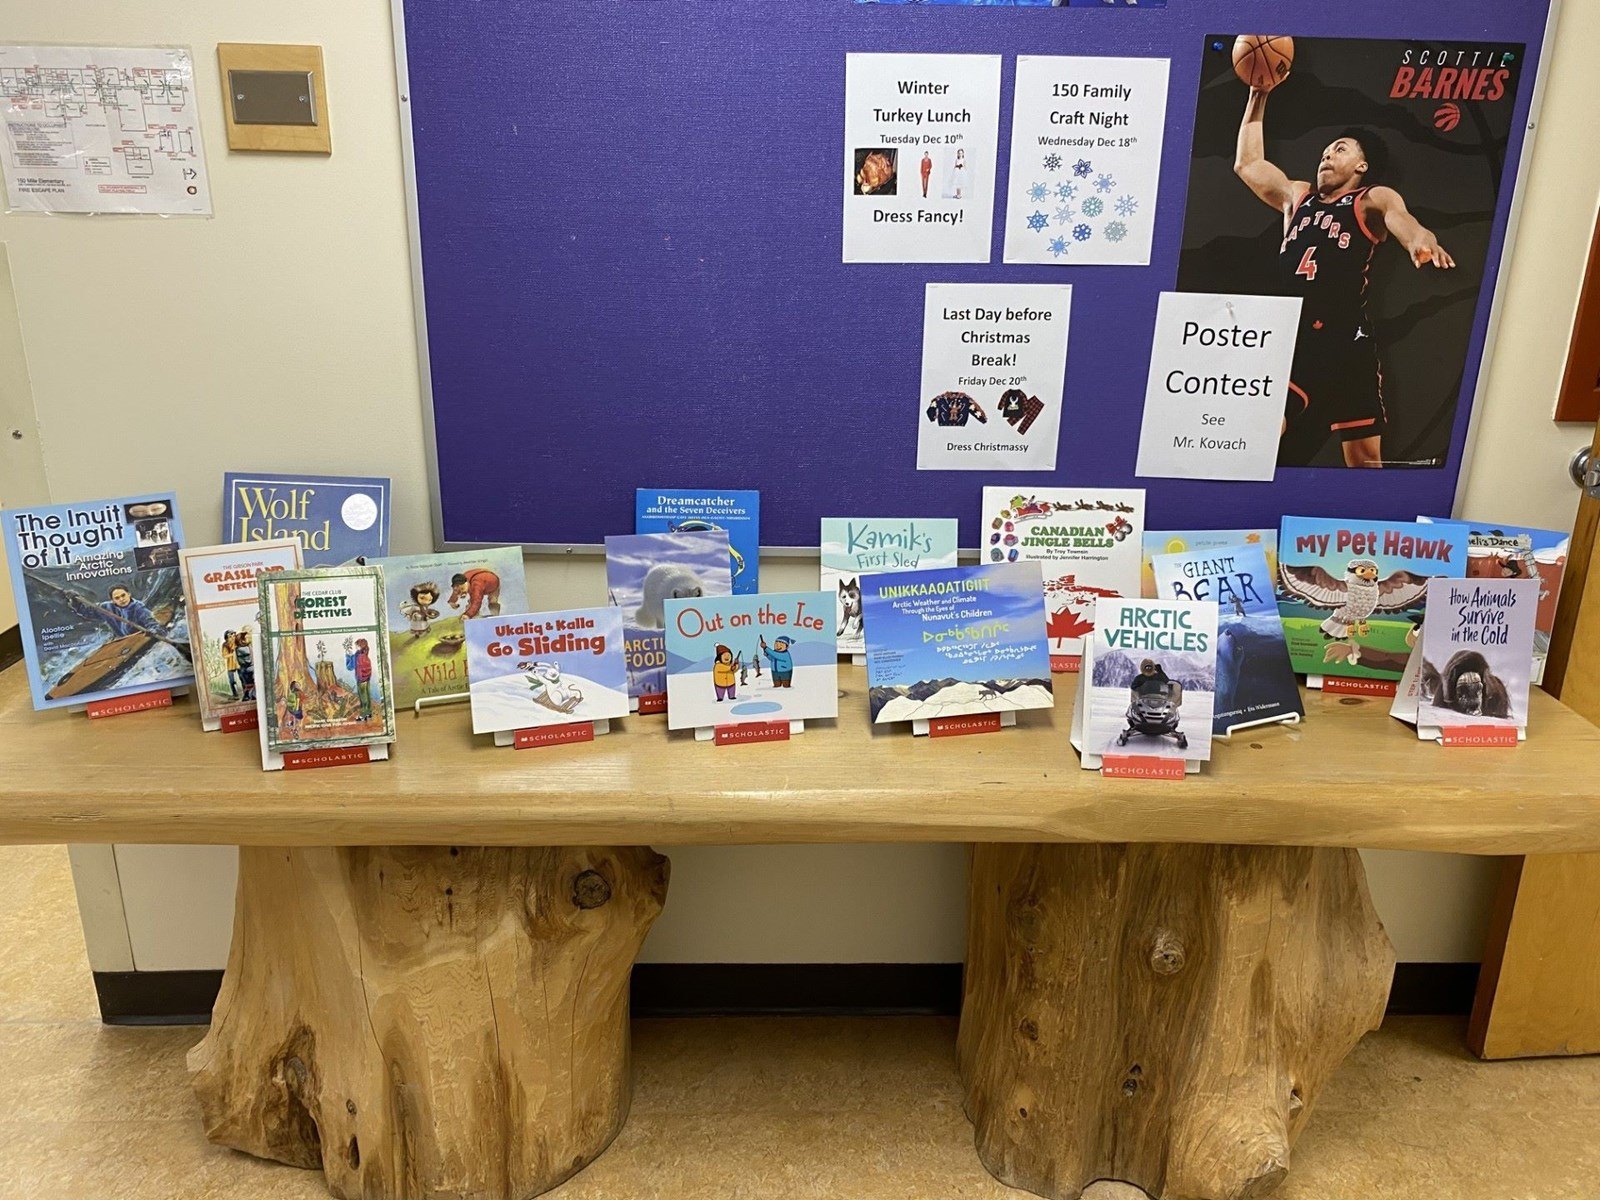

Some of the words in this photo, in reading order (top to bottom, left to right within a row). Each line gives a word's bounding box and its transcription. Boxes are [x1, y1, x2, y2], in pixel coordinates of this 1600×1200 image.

[898, 80, 950, 95] Winter
[1389, 66, 1510, 100] BARNES
[1052, 83, 1079, 97] 150
[1083, 84, 1132, 102] Family
[873, 108, 923, 125] Turkey
[927, 108, 972, 123] Lunch
[1049, 111, 1085, 126] Craft
[1089, 112, 1130, 129] Night
[880, 134, 920, 145] Tuesday
[922, 135, 942, 144] Dec
[944, 133, 964, 144] 10th
[1037, 136, 1094, 148] Wednesday
[1097, 137, 1116, 148] Dec
[1118, 137, 1138, 148] 18th
[873, 209, 913, 223] Dress
[917, 209, 964, 226] Fancy!
[1295, 246, 1318, 281] 4
[943, 307, 970, 321] Last
[975, 308, 1001, 324] Day
[1005, 308, 1052, 322] before
[961, 330, 1031, 345] Christmas
[1182, 321, 1272, 349] Poster
[971, 353, 1017, 367] Break!
[958, 376, 987, 387] Friday
[989, 376, 1007, 386] Dec
[1008, 375, 1028, 386] 20th
[1165, 369, 1273, 398] Contest
[1201, 412, 1226, 426] See
[946, 442, 972, 452] Dress
[974, 442, 1029, 454] Christmassy
[1172, 436, 1196, 450] Mr.
[1200, 436, 1247, 451] Kovach
[238, 487, 316, 520] Wolf
[657, 495, 736, 506] Dreamcatcher
[15, 512, 61, 533] The
[68, 505, 121, 528] Inuit
[646, 506, 662, 514] and
[664, 506, 678, 514] the
[680, 506, 704, 514] Seven
[706, 507, 746, 515] Deceivers
[18, 522, 124, 551] Thought
[847, 522, 932, 555] Kamik's
[1030, 526, 1105, 537] CANADIAN
[1021, 537, 1071, 547] JINGLE
[1073, 538, 1114, 548] BELLS
[1336, 530, 1376, 556] Pet
[1384, 530, 1453, 564] Hawk
[1488, 537, 1518, 547] Dance
[22, 549, 49, 569] of
[56, 547, 71, 565] It
[74, 551, 124, 564] Amazing
[78, 560, 114, 571] Arctic
[856, 552, 888, 569] First
[892, 553, 920, 568] Sled
[66, 565, 133, 582] Innovations
[1183, 556, 1235, 578] GIANT
[217, 580, 258, 592] DETECTI
[879, 578, 990, 599] UNIKKAAQATIGIIT
[1172, 573, 1264, 605] BEAR
[294, 596, 348, 608] FOREST
[892, 601, 912, 609] Arctic
[912, 598, 940, 607] Weather
[952, 596, 976, 604] Climate
[1449, 587, 1470, 606] How
[1470, 586, 1517, 608] Animals
[294, 608, 352, 620] DETECTIVES
[677, 608, 724, 638] Out
[730, 612, 752, 627] on
[758, 604, 787, 625] the
[793, 602, 824, 631] Ice
[922, 611, 960, 622] Nunavut's
[960, 609, 992, 618] Children
[1120, 607, 1192, 629] ARCTIC
[1458, 606, 1504, 628] Survive
[495, 620, 543, 637] Ukaliq
[545, 622, 554, 630] &
[556, 617, 594, 632] Kalla
[1452, 629, 1460, 643] in
[1462, 626, 1479, 642] the
[1481, 624, 1508, 645] Cold
[486, 642, 513, 658] Go
[518, 633, 605, 656] Sliding
[624, 637, 664, 652] ARCTI
[1104, 628, 1208, 653] VEHICLES
[414, 660, 458, 685] Wild
[1336, 681, 1389, 690] SCHOLASTIC
[100, 698, 169, 715] SCHOLASTIC
[729, 728, 784, 739] SCHOLASTIC
[942, 720, 997, 730] SCHOLASTIC
[529, 730, 587, 741] SCHOLASTIC
[1452, 736, 1516, 744] SCHOLASTIC
[301, 753, 364, 764] SCHOLASTIC
[1114, 766, 1183, 776] SCHOLASTIC
